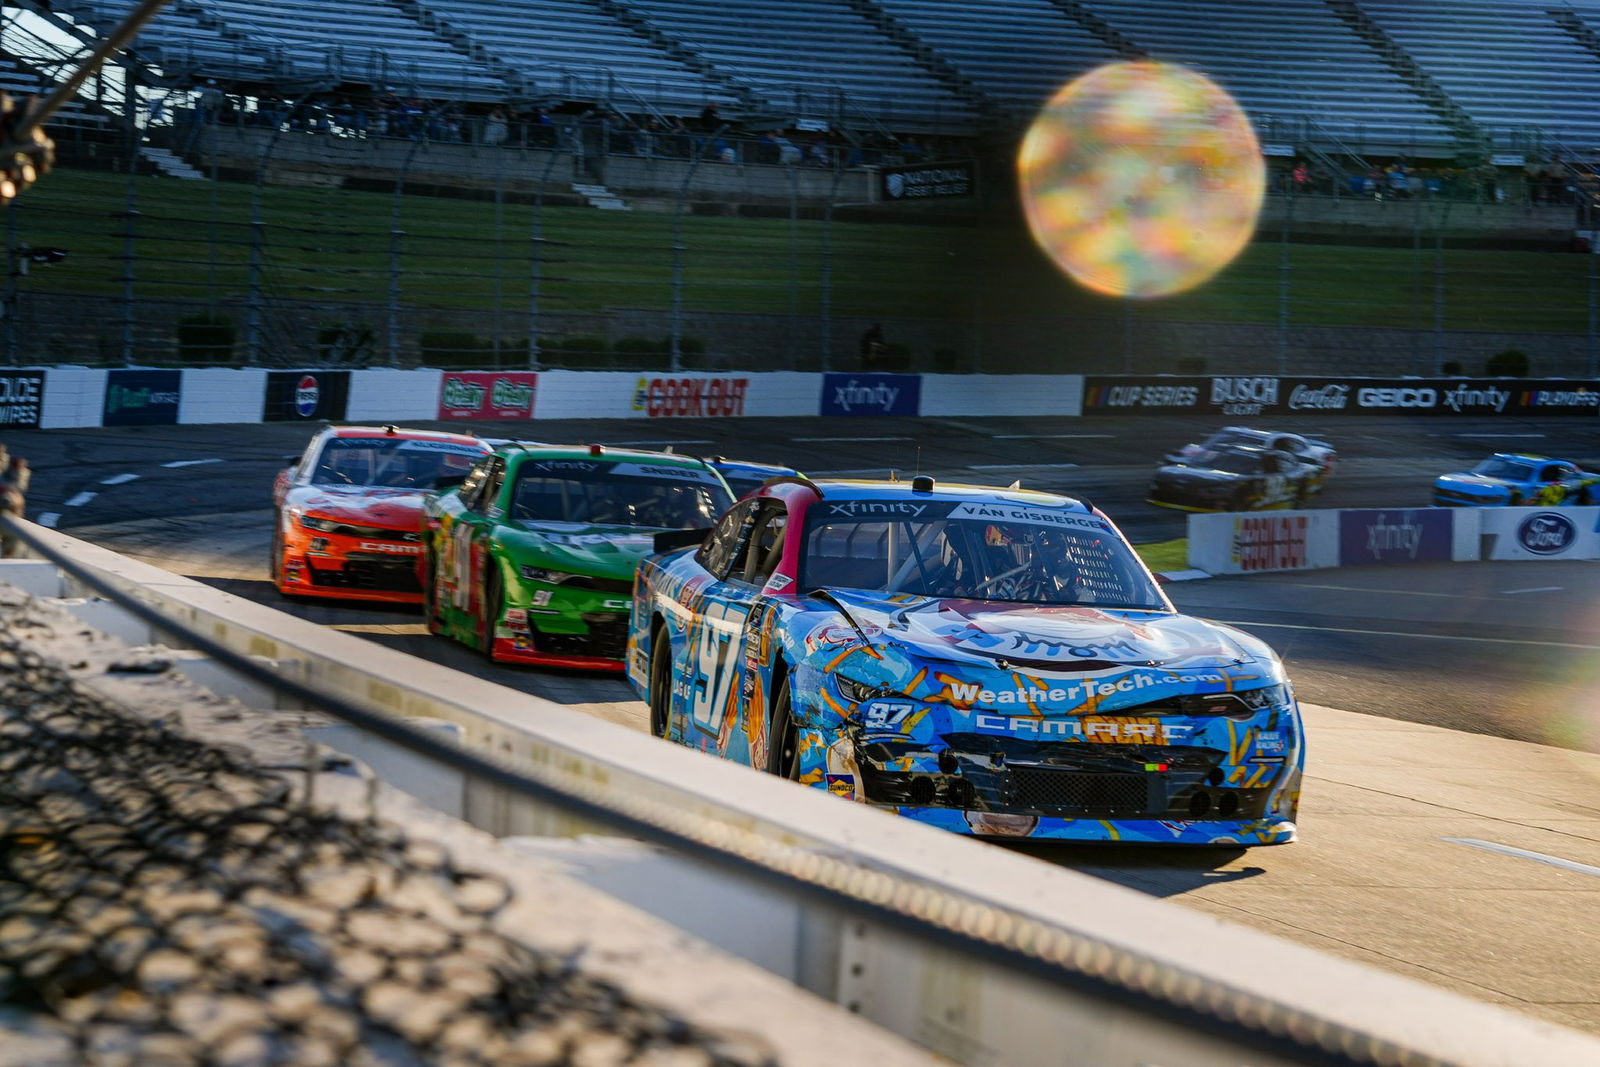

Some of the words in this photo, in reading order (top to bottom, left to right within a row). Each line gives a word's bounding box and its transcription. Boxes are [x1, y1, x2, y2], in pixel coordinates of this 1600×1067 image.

[833, 380, 900, 411] xfinity
[1108, 387, 1141, 406] CUP
[1142, 386, 1199, 406] SERIES
[1210, 378, 1279, 405] BUSCH
[1357, 387, 1437, 408] GEICO
[1443, 384, 1511, 412] xfinity
[830, 502, 928, 517] xfinity
[963, 506, 1005, 517] VAN
[1011, 510, 1104, 529] GISBERGE
[1525, 518, 1567, 547] Ford
[532, 590, 553, 606] 91
[694, 601, 749, 730] 97
[950, 673, 1224, 704] WeatherTech.com
[865, 702, 913, 729] 97
[829, 784, 855, 792] SUNOCO
